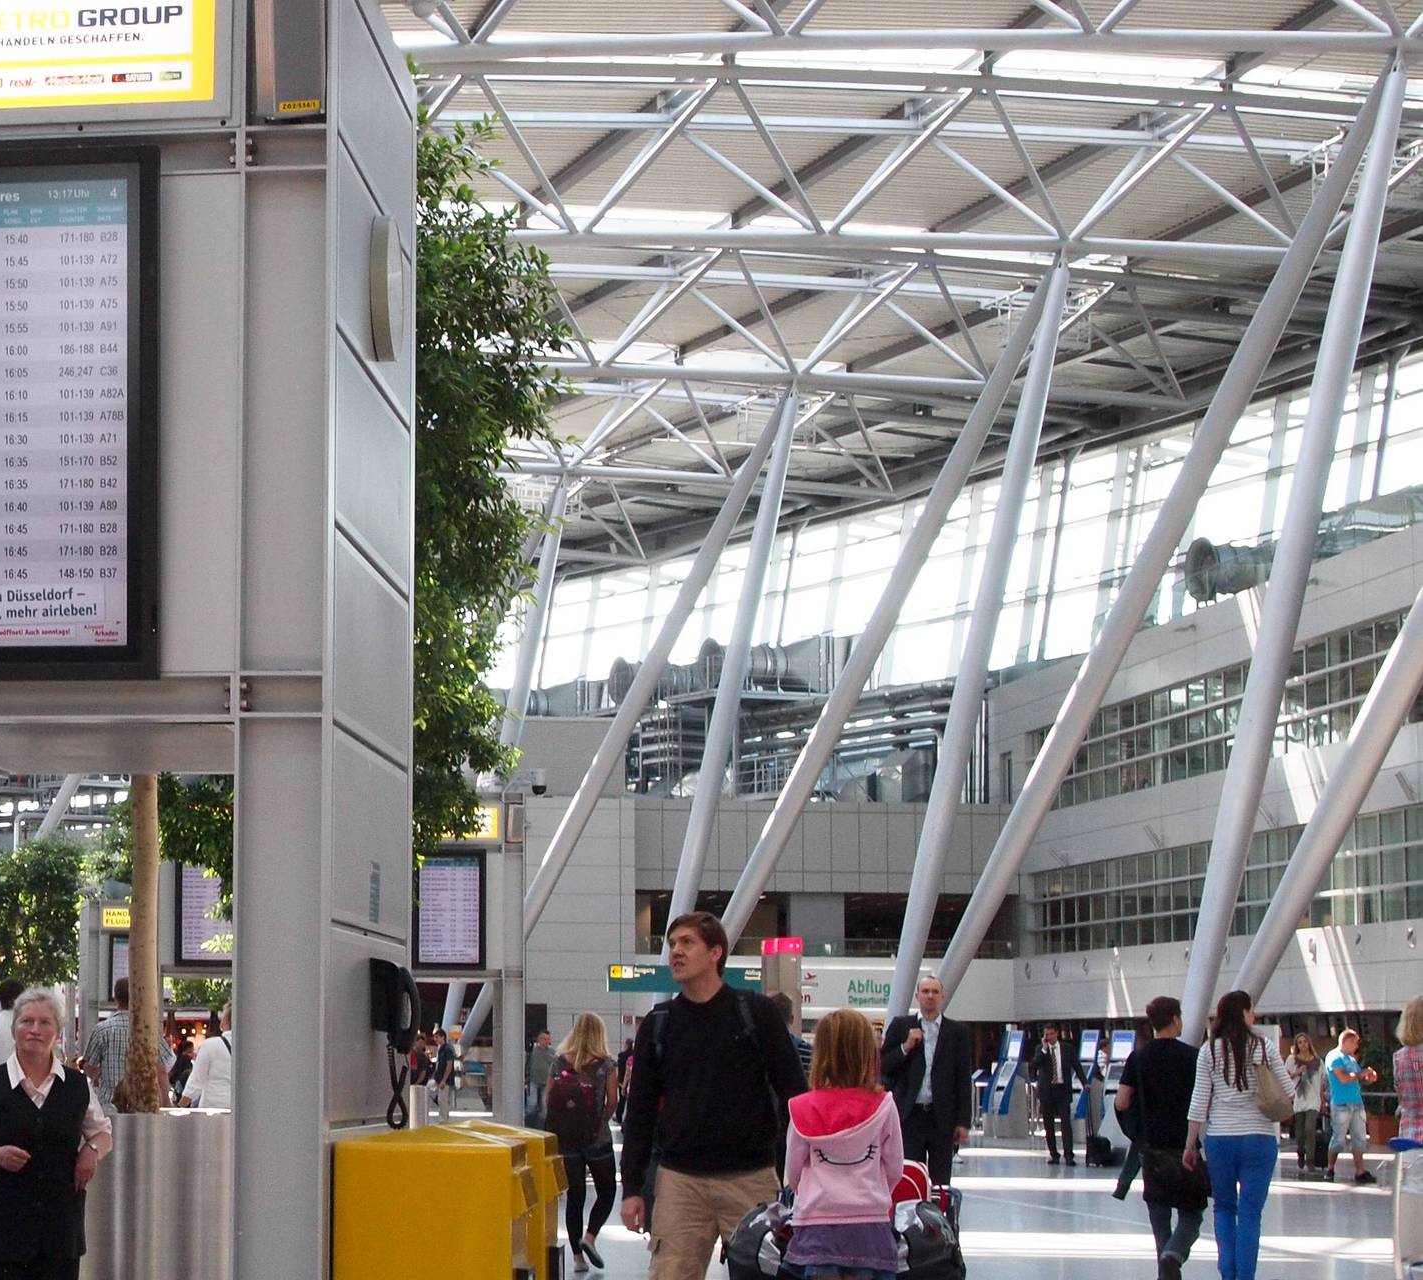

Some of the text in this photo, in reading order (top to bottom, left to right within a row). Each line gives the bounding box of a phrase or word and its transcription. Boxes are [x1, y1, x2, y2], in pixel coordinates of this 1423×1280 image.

[77, 5, 184, 27] GROUP
[59, 33, 144, 45] GESCHAFFEN.
[110, 188, 117, 198] 4
[7, 588, 73, 602] Düsseldorf
[6, 607, 37, 618] mehr
[42, 603, 97, 617] airleben!
[848, 980, 891, 997] Abflug
